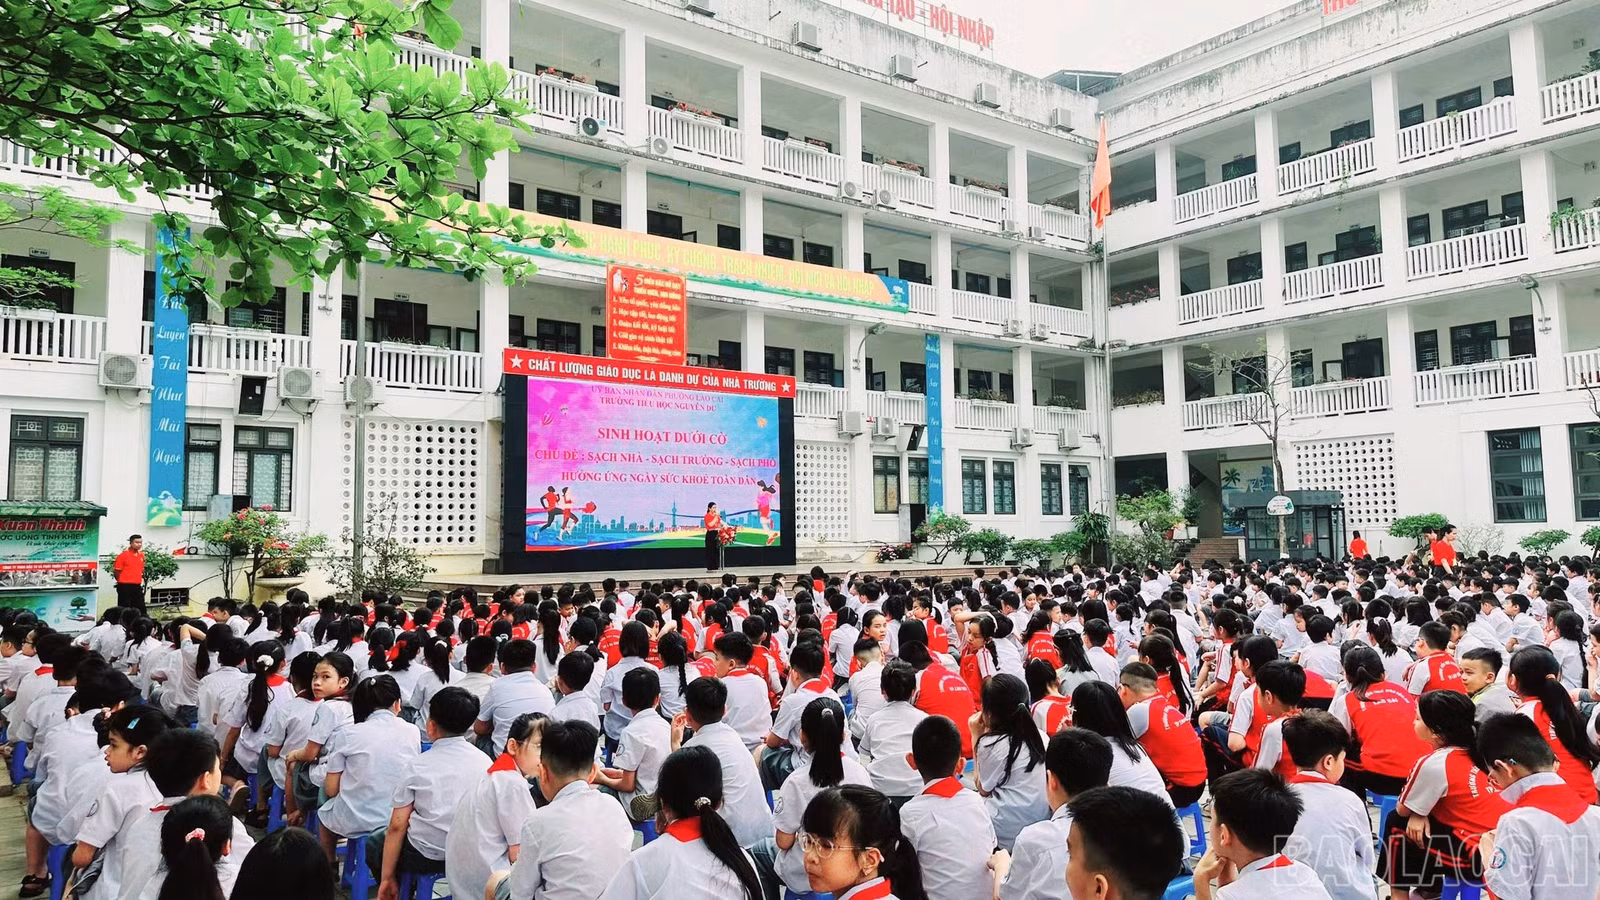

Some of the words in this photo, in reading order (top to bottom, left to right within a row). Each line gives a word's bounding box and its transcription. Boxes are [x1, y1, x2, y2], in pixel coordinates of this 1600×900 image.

[929, 4, 954, 37] HỘI
[957, 15, 994, 51] NHẬP
[634, 274, 644, 286] 5
[156, 325, 185, 342] Luyện
[159, 355, 181, 370] Tài
[528, 356, 556, 372] CHẤT
[559, 361, 594, 377] LƯỢNG
[596, 364, 619, 378] GIÁO
[622, 367, 641, 382] DỤC
[644, 368, 656, 381] LÀ
[659, 371, 684, 385] DANH
[686, 373, 699, 387] DỰ
[702, 372, 720, 387] CỦA
[722, 376, 741, 389] NHÀ
[743, 378, 777, 392] TRƯỜNG
[154, 386, 184, 401] Như
[604, 386, 621, 395] BAN
[656, 400, 674, 410] HỌC
[706, 404, 717, 412] DU
[154, 417, 181, 432] Mài
[597, 427, 630, 441] SINH
[634, 430, 671, 445] HOẠT
[674, 430, 706, 445] DƯỚI
[709, 431, 728, 446] CỜ
[152, 448, 181, 466] Ngọc
[534, 448, 560, 460] CHỦ
[587, 451, 618, 464] SẠCH
[620, 451, 644, 463] NHÀ
[651, 454, 679, 466] SẠCH
[682, 454, 724, 466] TRƯỜNG
[730, 457, 756, 469] SẠCH
[604, 470, 628, 482] ỨNG
[629, 472, 658, 483] NGÀY
[660, 472, 680, 484] SỨC
[711, 474, 736, 485] TOÀN
